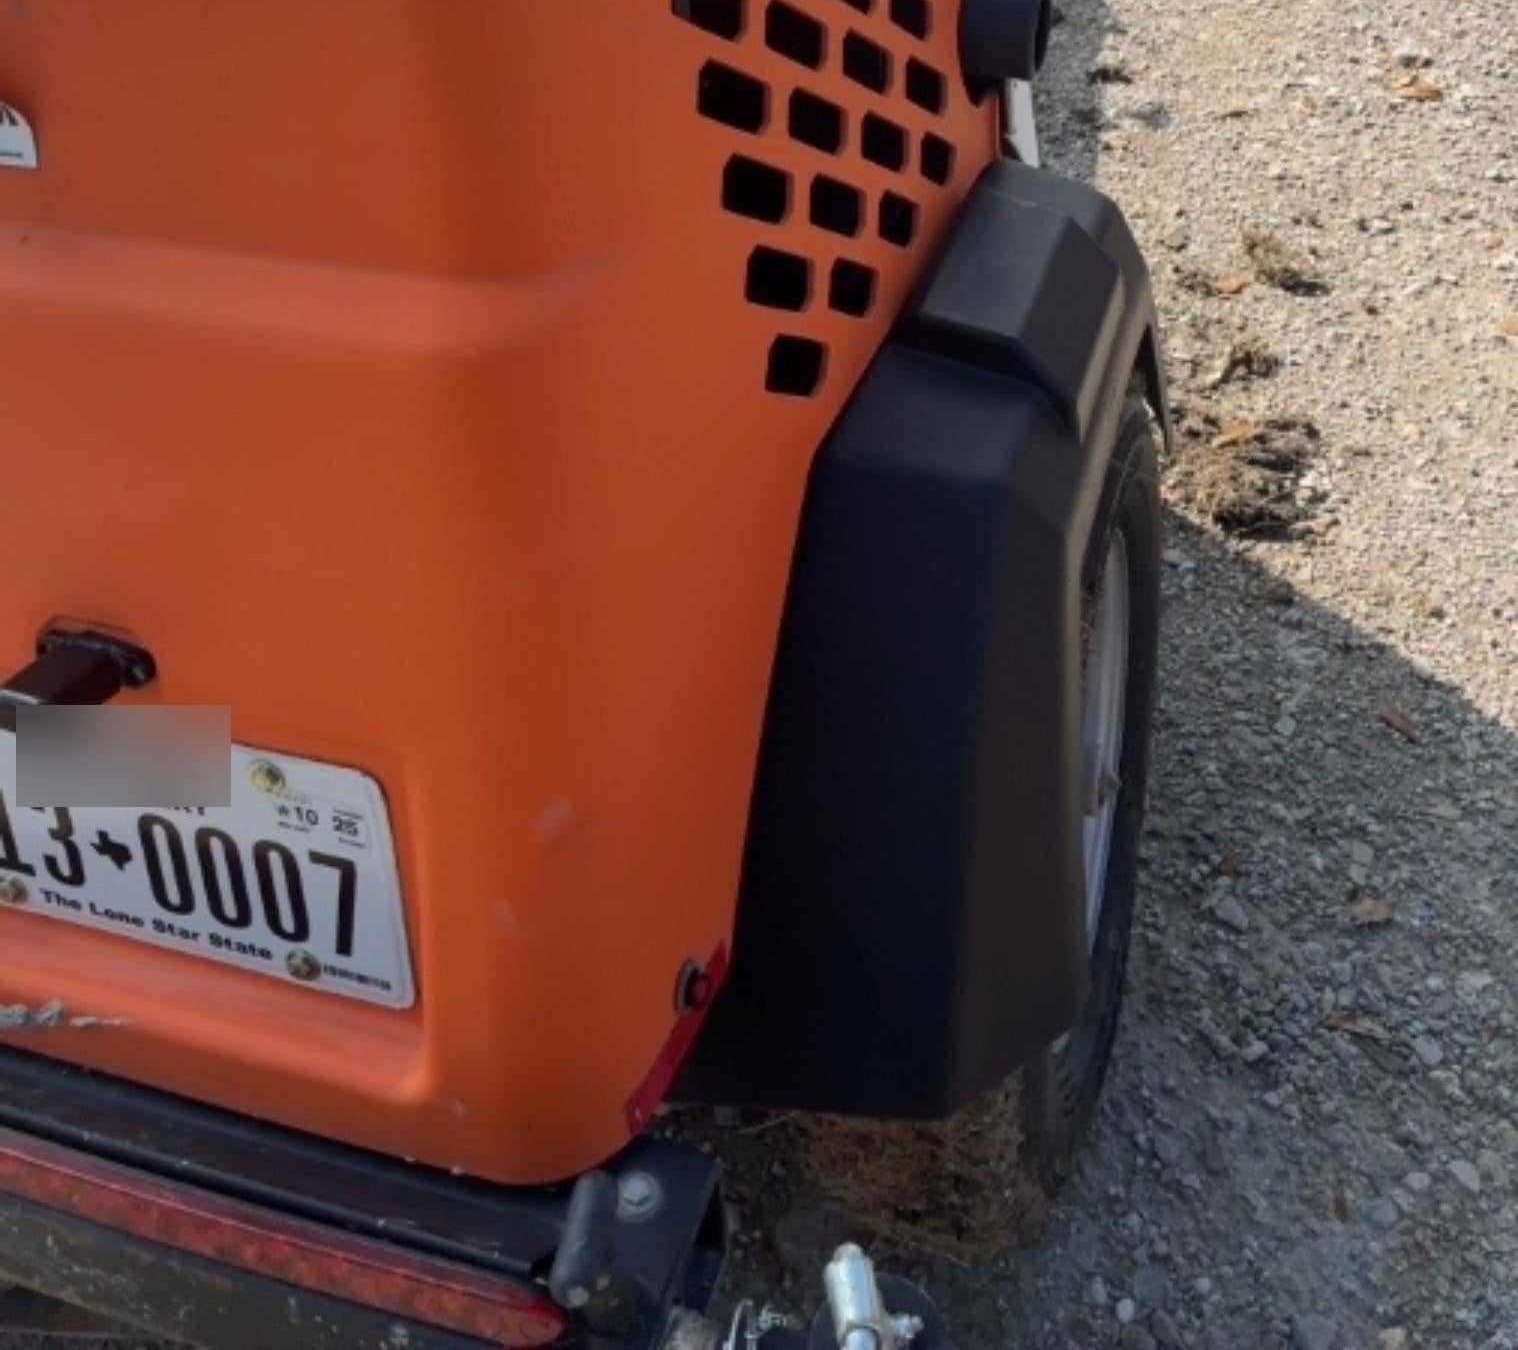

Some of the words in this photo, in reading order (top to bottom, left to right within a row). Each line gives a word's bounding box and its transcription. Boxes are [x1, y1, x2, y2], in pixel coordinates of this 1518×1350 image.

[39, 888, 82, 912] The
[89, 902, 144, 928] Lone
[152, 917, 201, 942] Star
[208, 932, 272, 961] State
